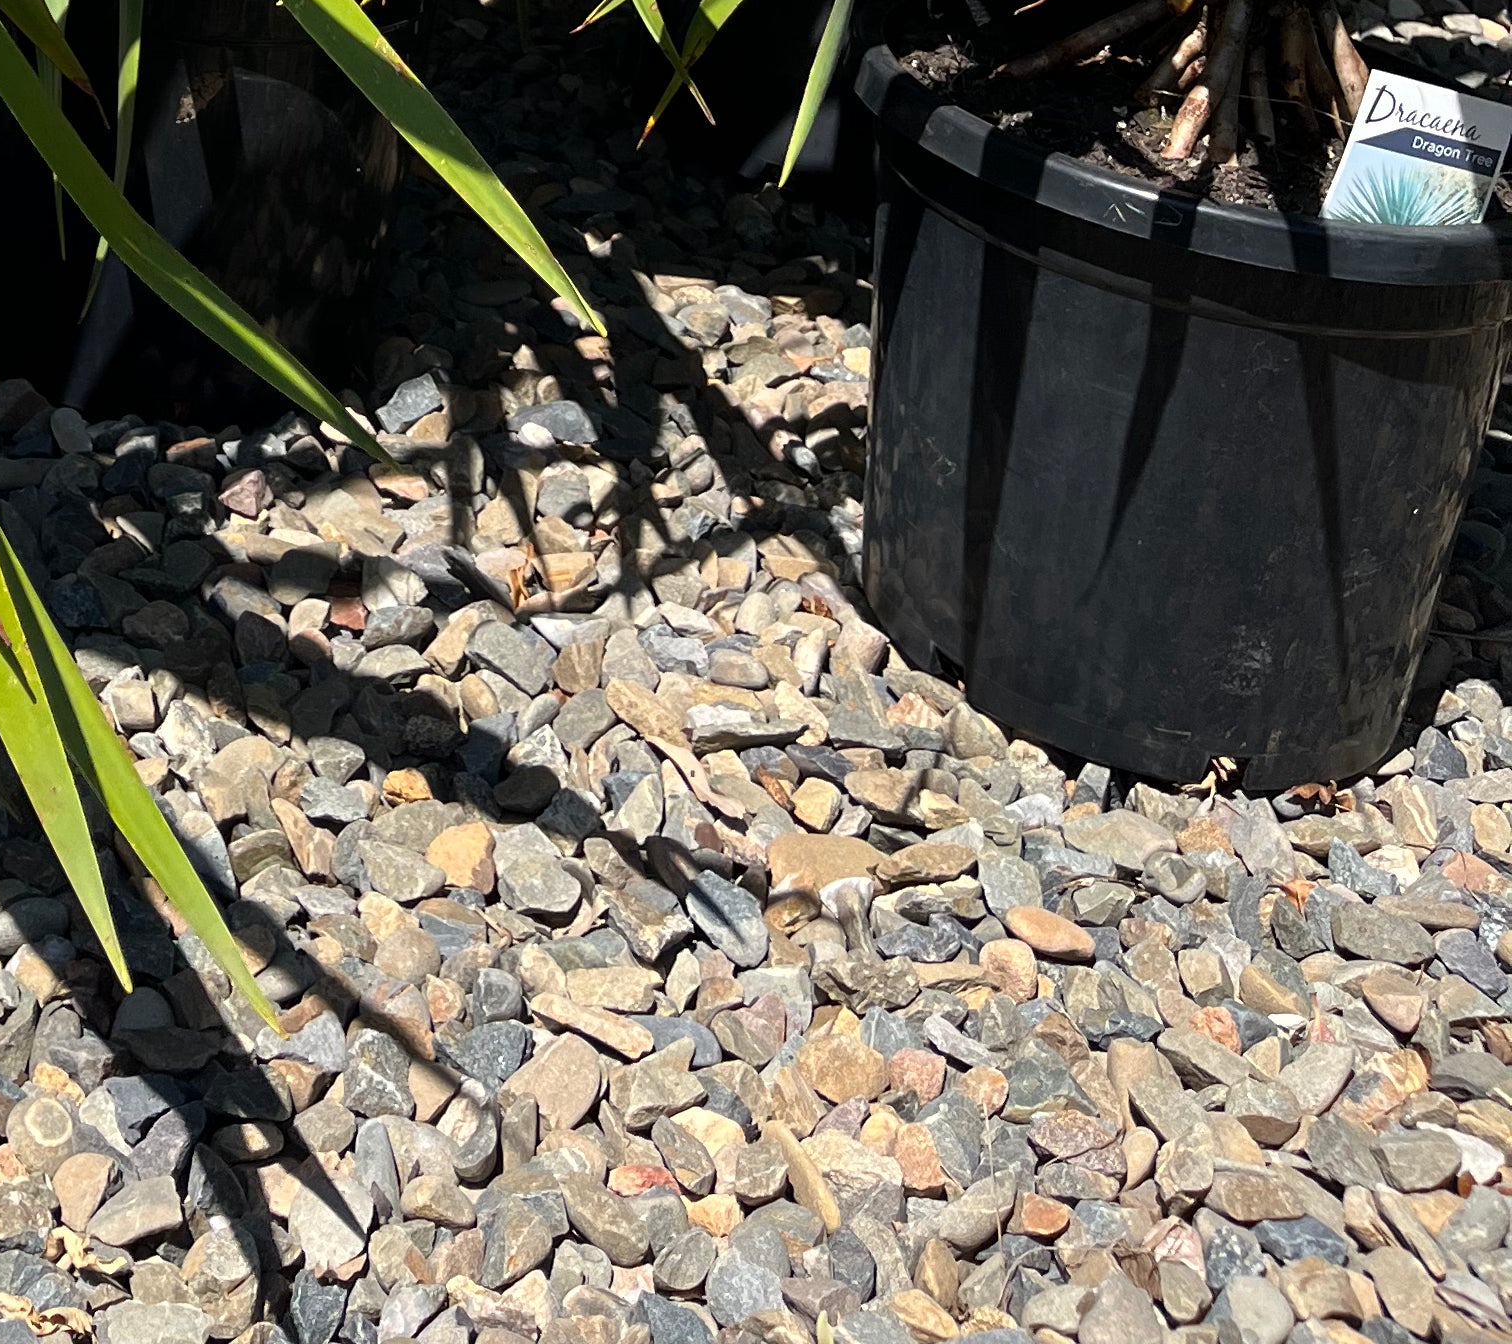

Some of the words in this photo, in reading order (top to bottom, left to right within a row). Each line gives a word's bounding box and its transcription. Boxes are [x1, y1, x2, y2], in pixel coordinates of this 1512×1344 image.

[1365, 84, 1481, 140] Dracaena
[1411, 135, 1461, 160] Dragon
[1465, 148, 1494, 168] Tree
